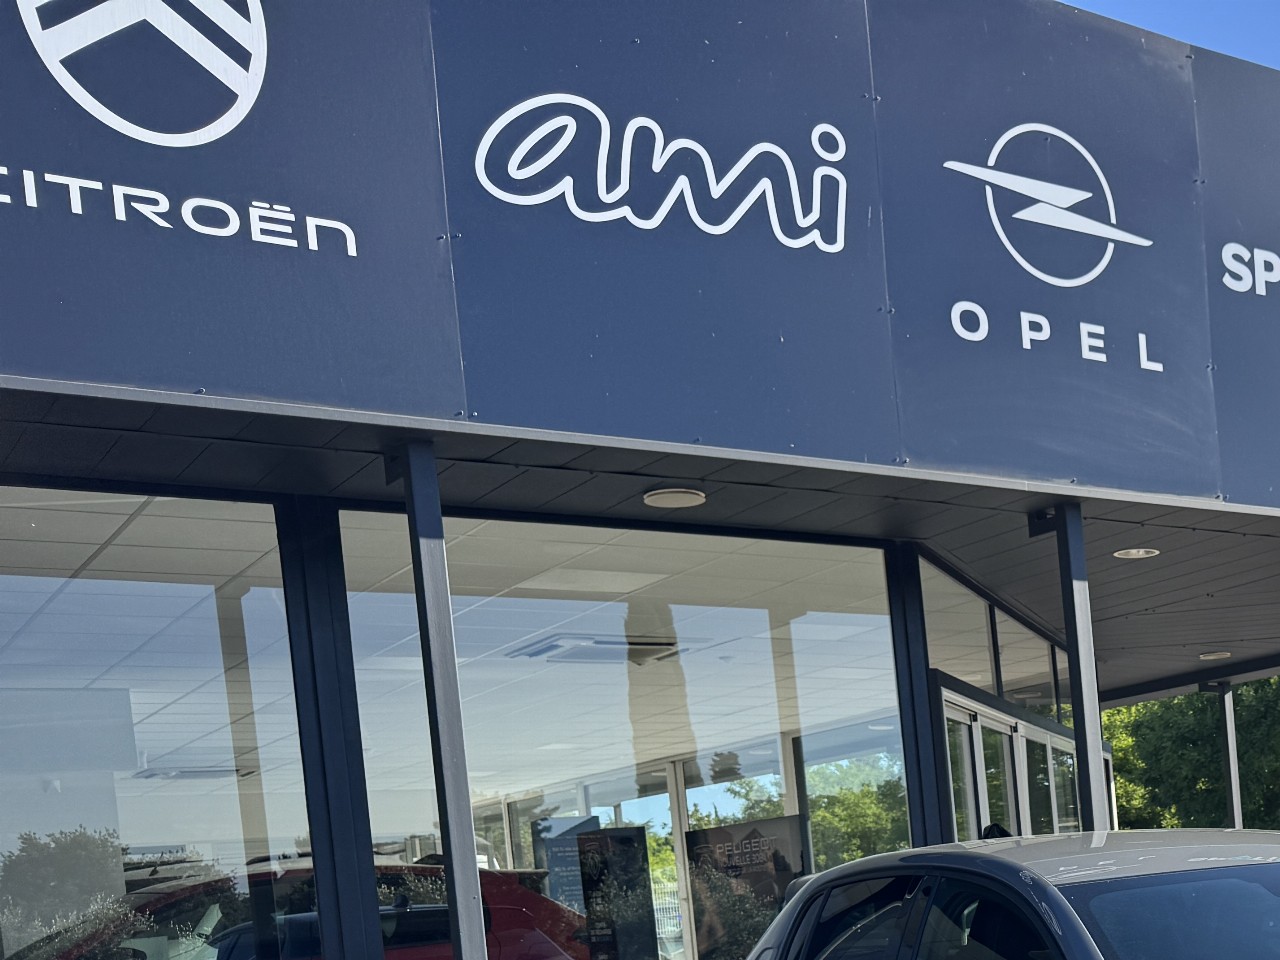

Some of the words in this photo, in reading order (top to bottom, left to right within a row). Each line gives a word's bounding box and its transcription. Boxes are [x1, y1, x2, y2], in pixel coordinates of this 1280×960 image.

[0, 166, 358, 257] ITROËN
[475, 93, 846, 253] ami
[950, 300, 1164, 372] OPEL
[716, 836, 777, 856] PEUGEOT
